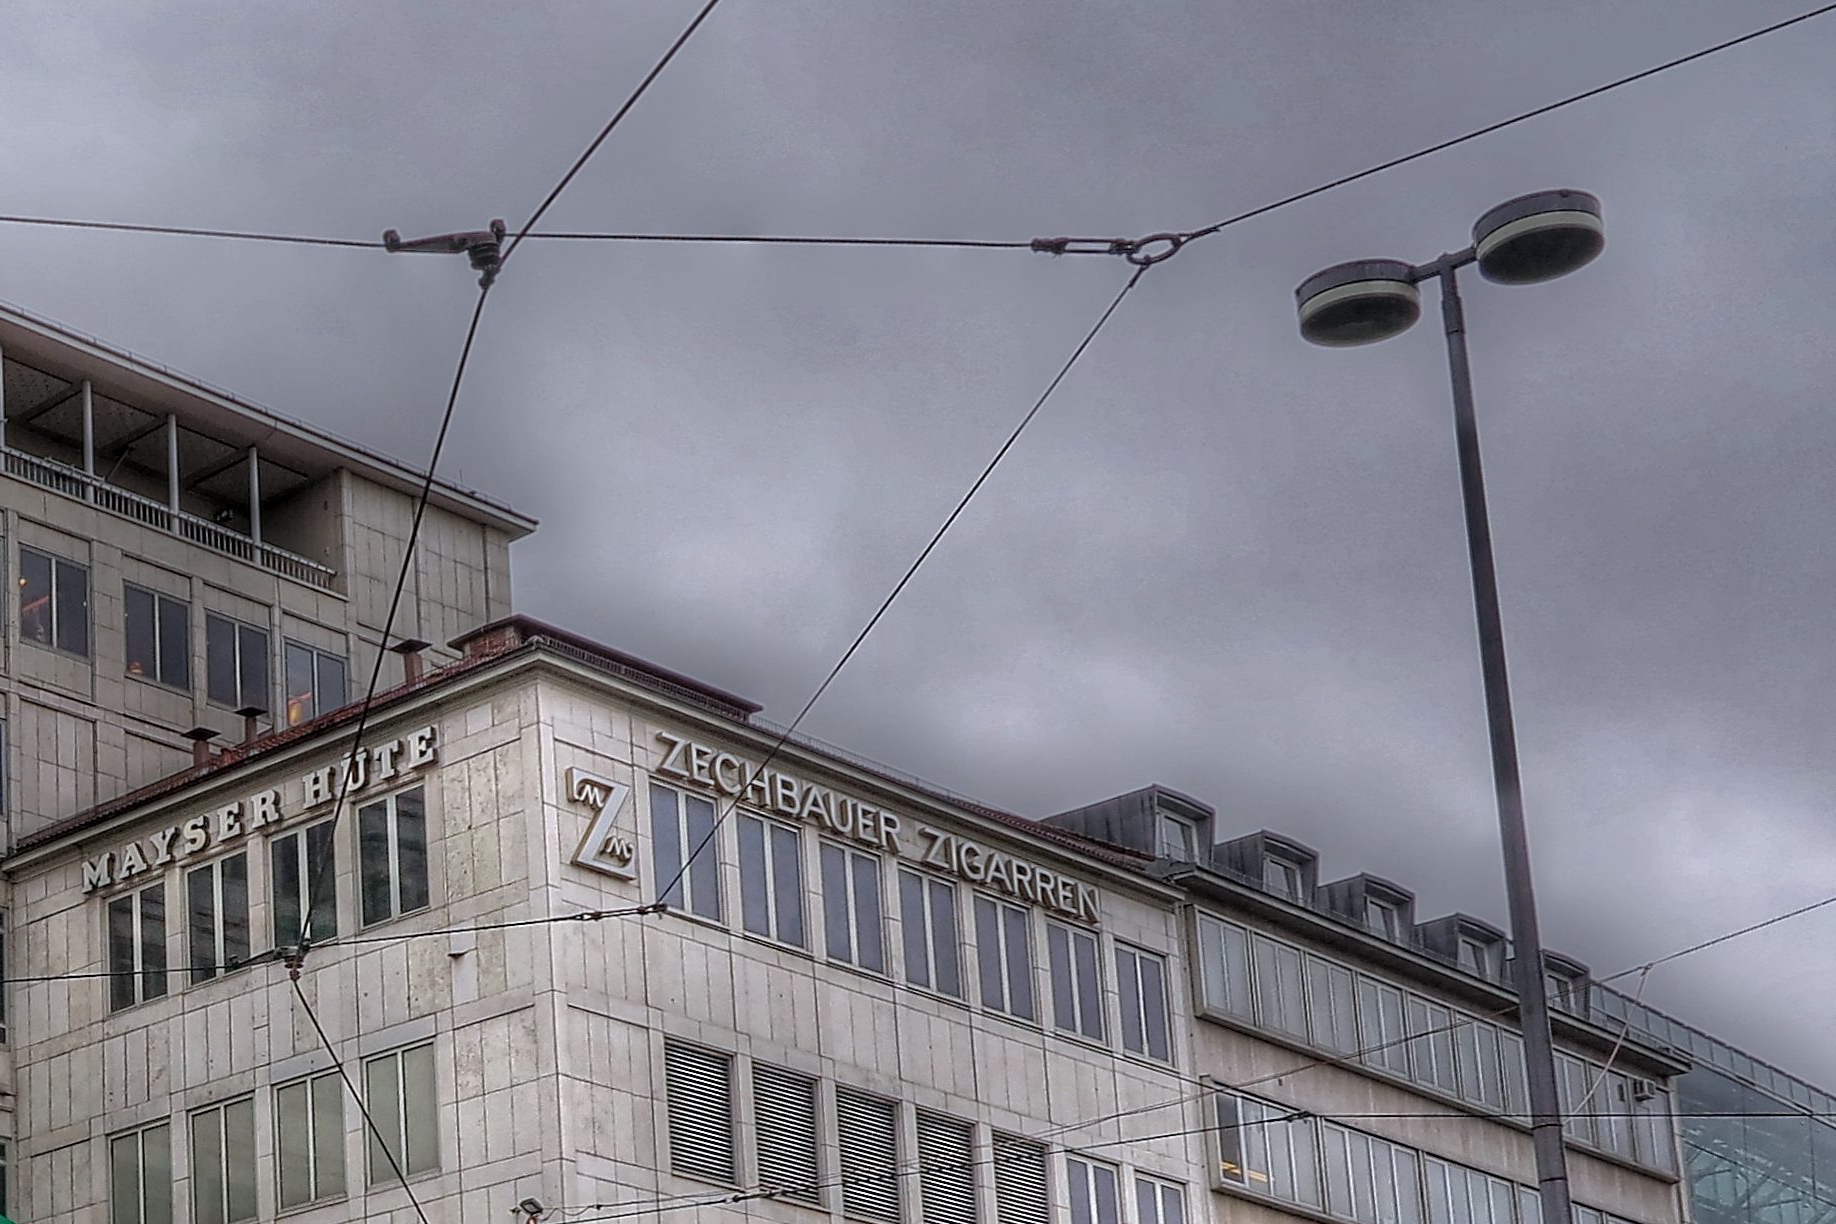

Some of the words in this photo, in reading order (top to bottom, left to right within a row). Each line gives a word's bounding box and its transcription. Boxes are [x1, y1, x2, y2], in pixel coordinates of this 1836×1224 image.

[81, 789, 281, 894] MAYSER
[301, 725, 437, 809] HÜTE
[656, 731, 902, 853] ZECHBAUER
[916, 826, 1101, 923] ZIGARREN
